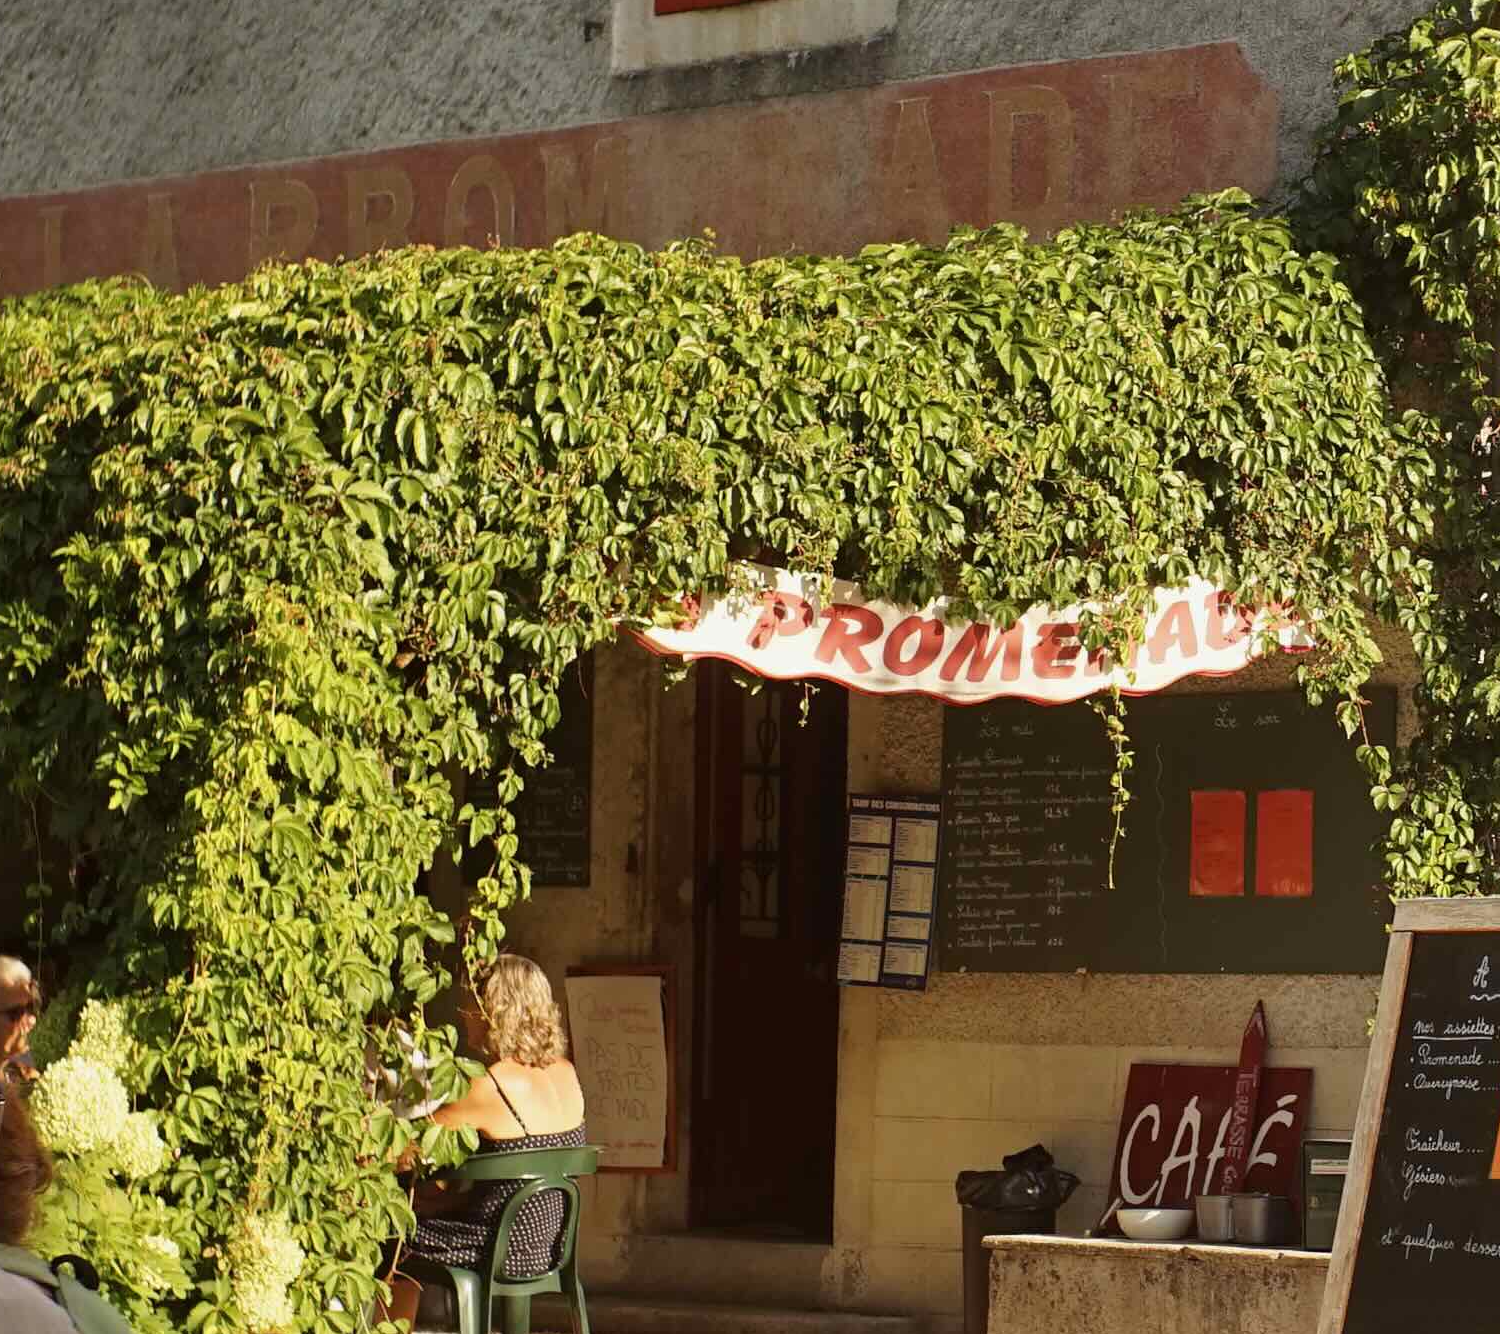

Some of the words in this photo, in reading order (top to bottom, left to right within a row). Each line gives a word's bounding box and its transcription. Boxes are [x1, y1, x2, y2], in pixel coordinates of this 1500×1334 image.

[1121, 1094, 1298, 1207] CAFÉ
[1227, 1066, 1260, 1161] TERRASSE
[1402, 1223, 1455, 1263] quelques
